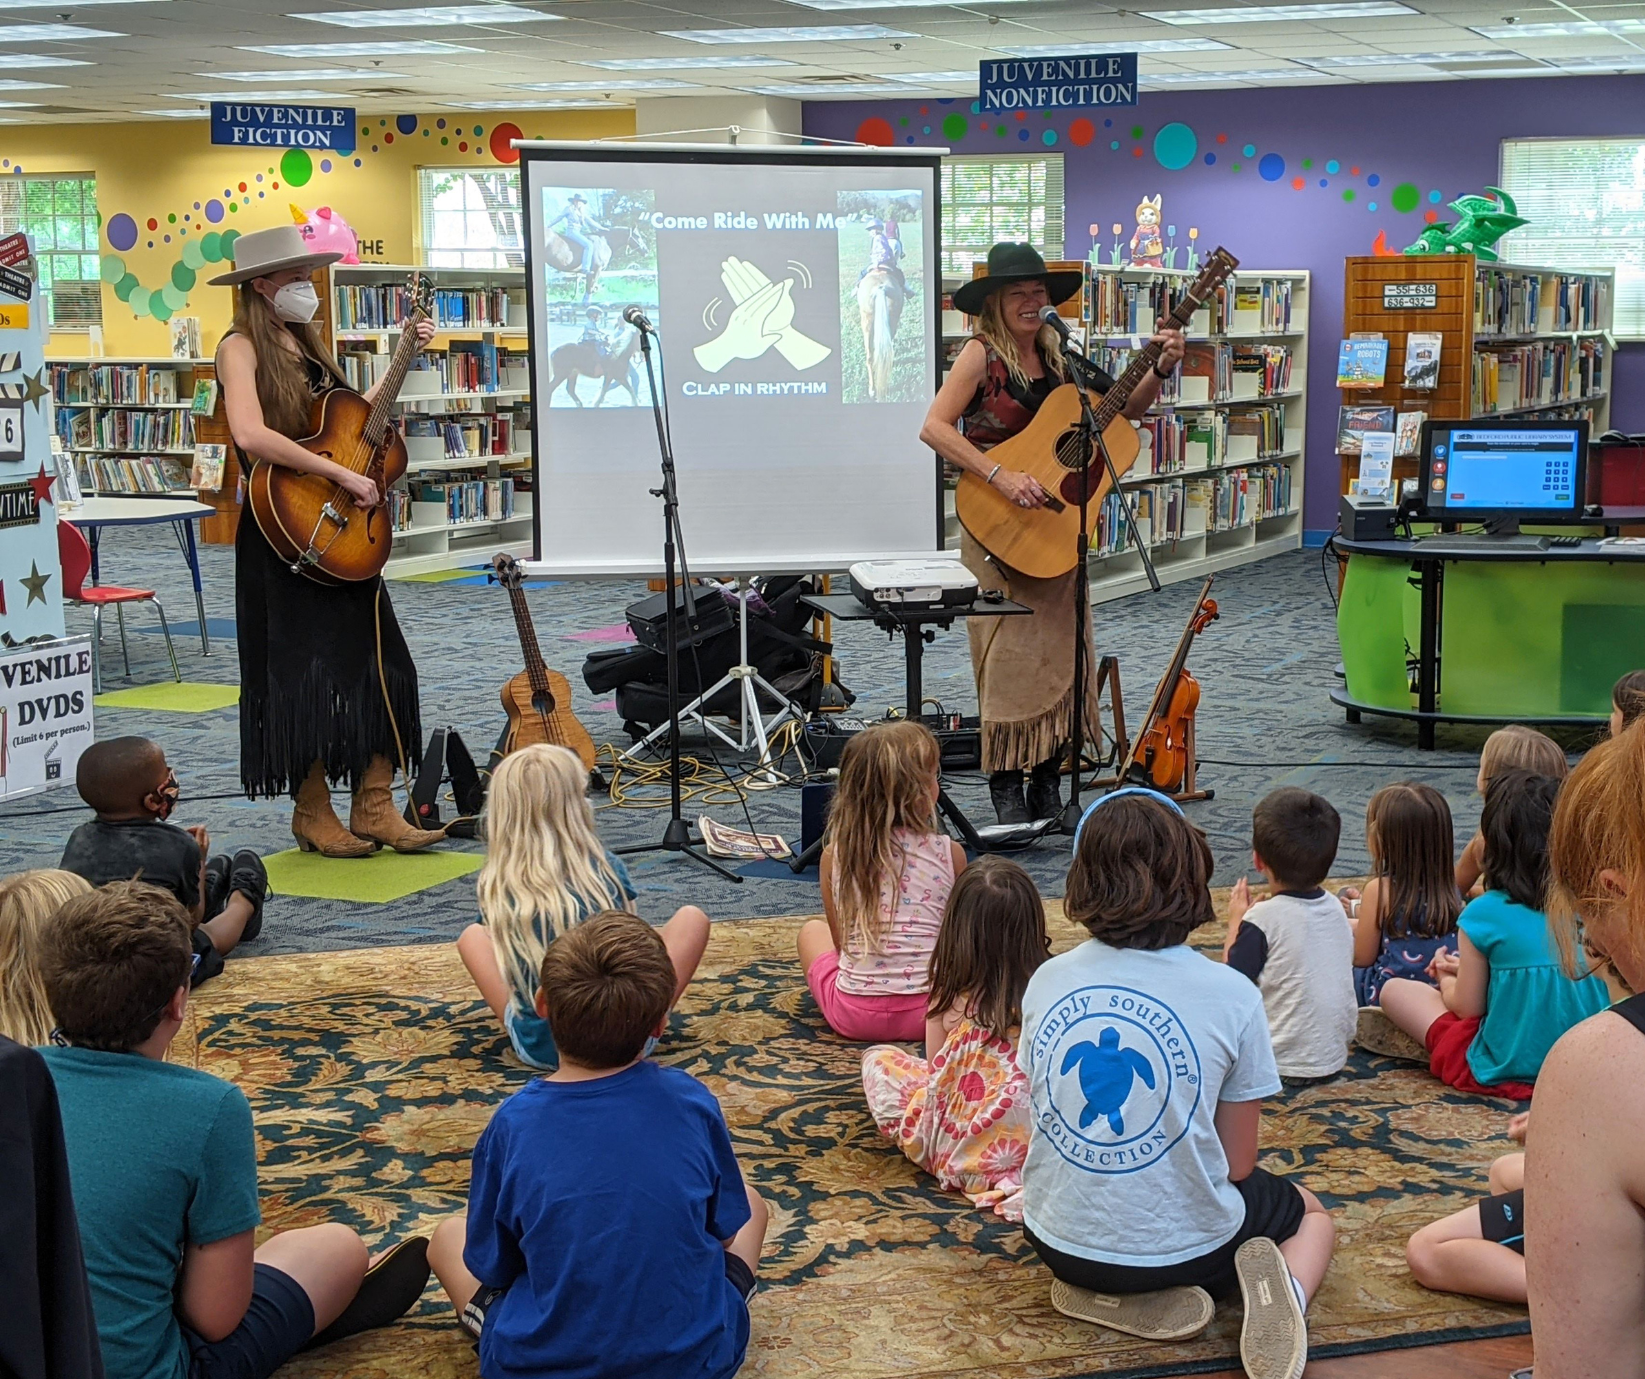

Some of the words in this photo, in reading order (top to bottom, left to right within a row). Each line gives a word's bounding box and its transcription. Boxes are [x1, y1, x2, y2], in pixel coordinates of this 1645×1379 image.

[987, 57, 1122, 84] JUVENILE
[985, 82, 1133, 109] NONFICTION
[221, 105, 346, 127] JUVENILE
[231, 127, 332, 147] FICTION
[713, 211, 759, 230] Ride
[763, 212, 810, 230] With
[356, 239, 384, 256] THE
[4, 271, 25, 286] THEATRE
[17, 289, 28, 298] ONE
[1357, 350, 1381, 359] ROBOTS
[682, 381, 731, 396] CLAP
[735, 382, 753, 395] IN
[756, 381, 827, 395] RHYTHM
[4, 418, 14, 444] 6
[1348, 420, 1382, 430] FRIEND
[0, 650, 91, 688] VENILE
[18, 690, 85, 726] DVDS
[12, 733, 38, 748] (Limit
[38, 732, 44, 740] 6
[45, 731, 59, 741] per
[60, 721, 91, 738] person.)
[1035, 995, 1092, 1059] simply
[1041, 1112, 1169, 1166] COLLECTION
